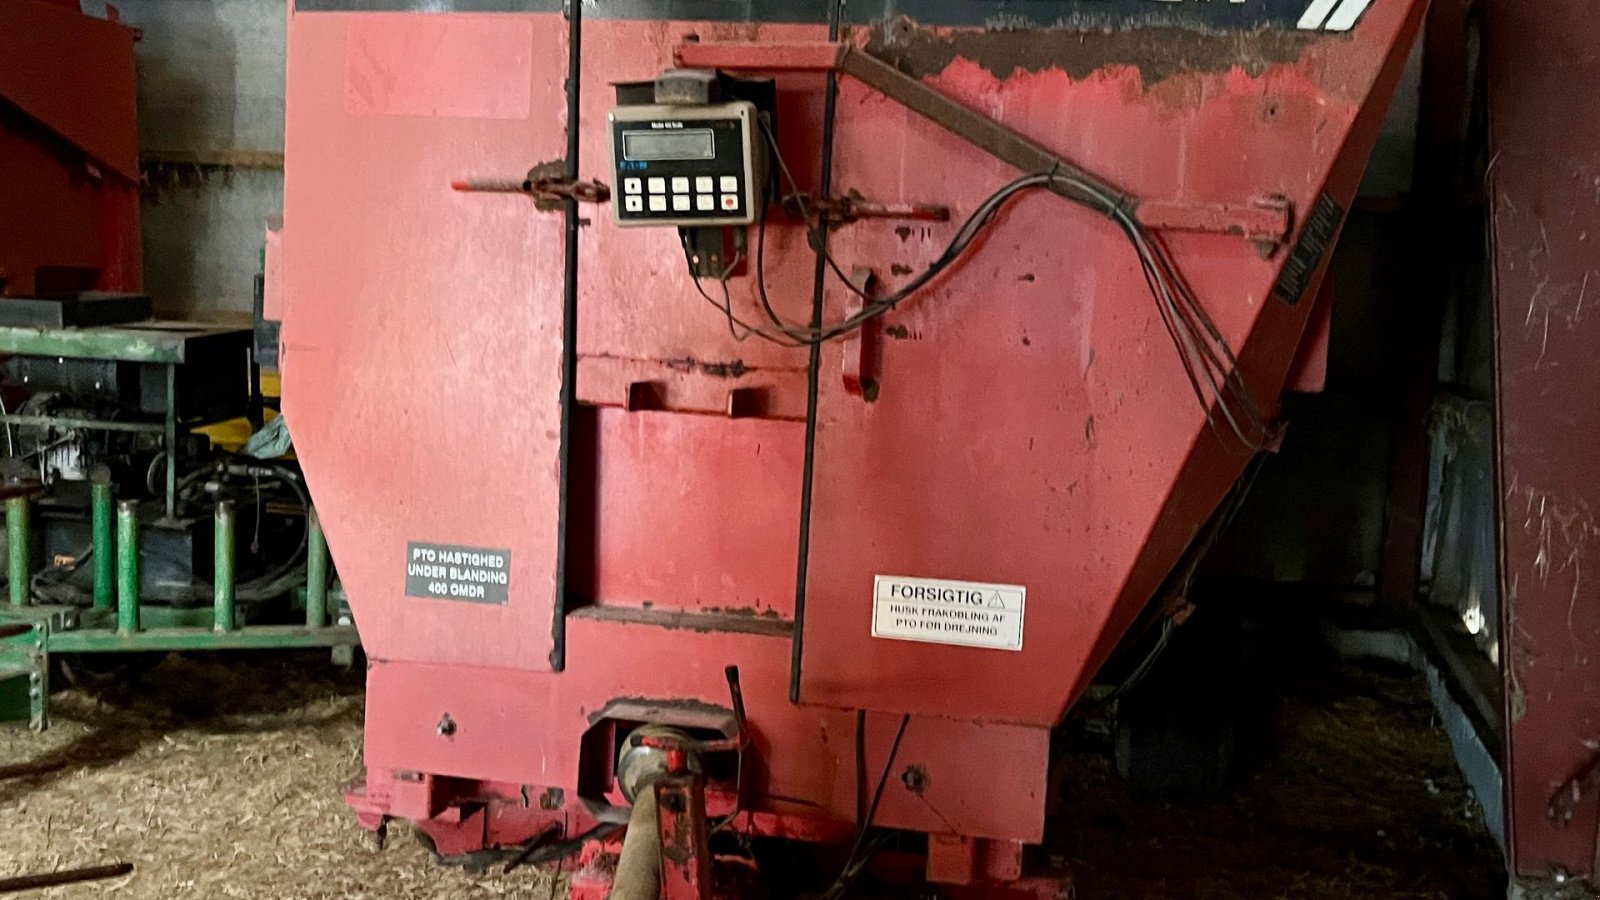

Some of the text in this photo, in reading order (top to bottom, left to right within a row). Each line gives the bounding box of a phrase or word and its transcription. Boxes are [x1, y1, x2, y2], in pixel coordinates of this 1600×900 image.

[413, 548, 504, 568] PTO HASTIGHED
[408, 563, 507, 584] UNDER BLANDING
[428, 581, 485, 598] 400 OMDR
[891, 584, 983, 605] FORSIGTIG
[890, 604, 918, 615] HUSK
[922, 607, 989, 622] FRAKOBLING
[896, 618, 917, 629] PTO
[944, 623, 998, 636] DREJNING
